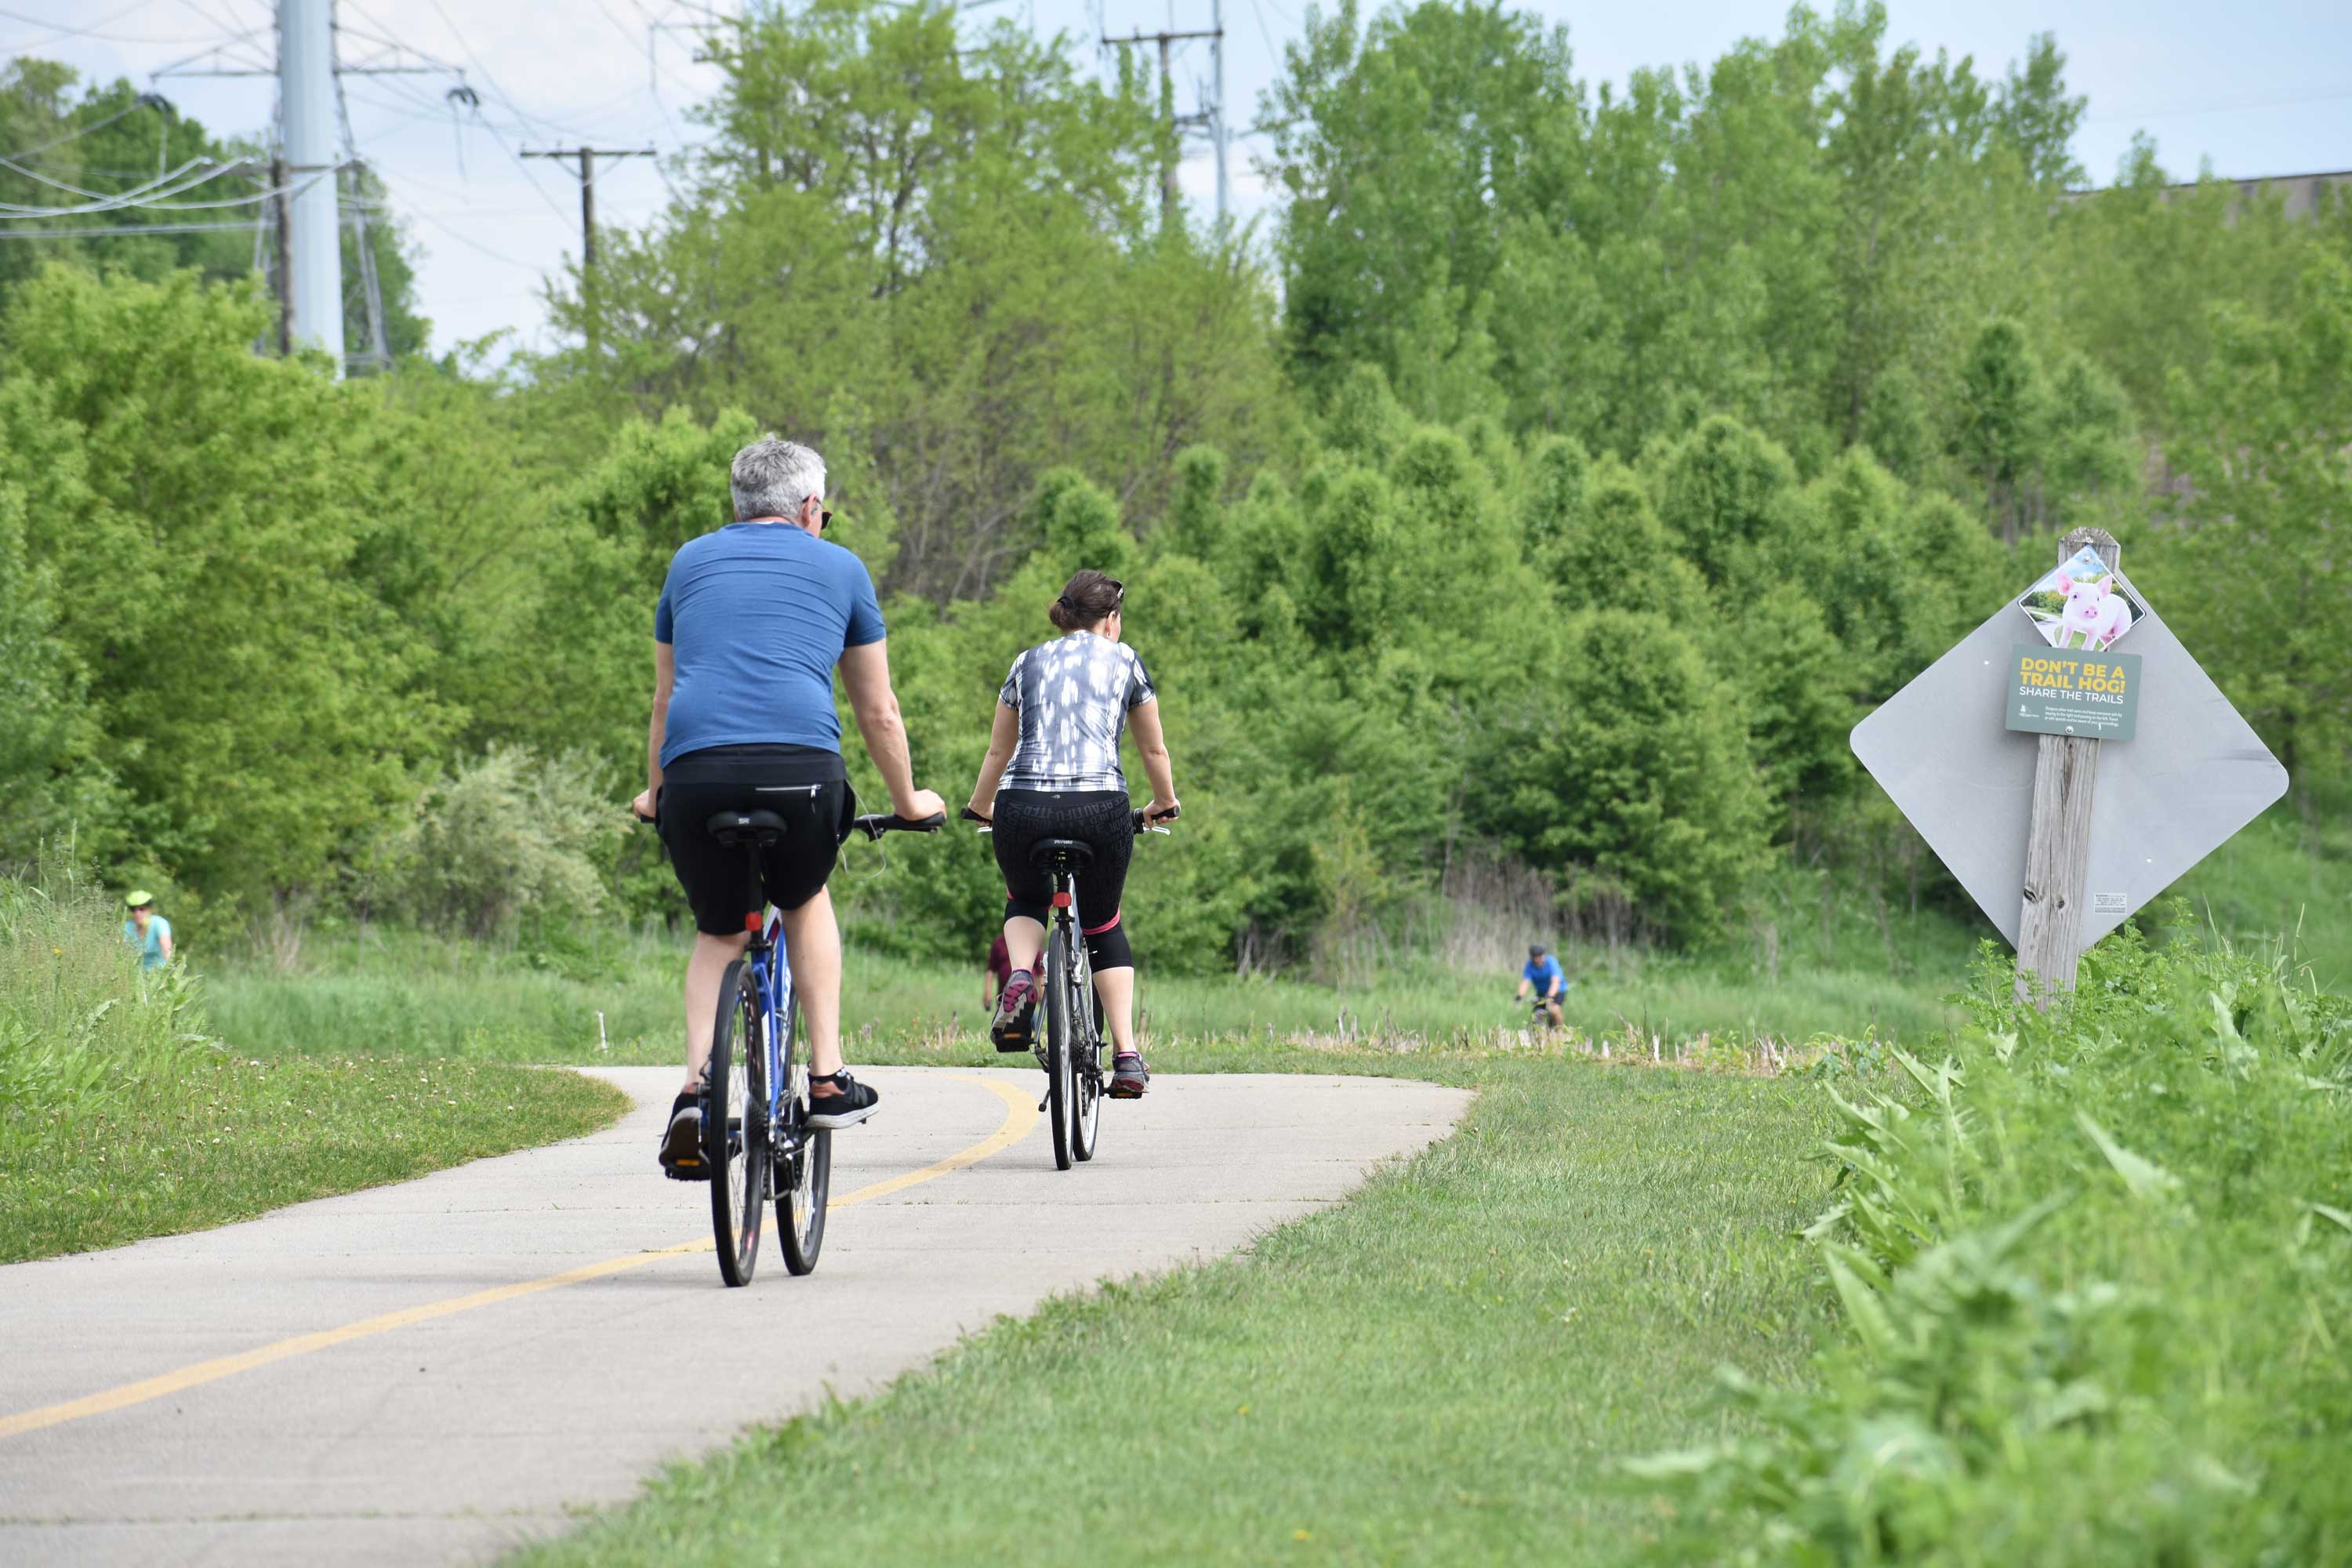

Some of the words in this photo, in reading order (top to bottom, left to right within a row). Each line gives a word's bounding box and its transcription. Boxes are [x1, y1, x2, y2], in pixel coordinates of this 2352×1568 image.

[2020, 657, 2078, 675] DON'T
[2083, 663, 2107, 677] BE
[2111, 665, 2125, 679] A
[2020, 671, 2073, 689] TRAIL
[2078, 677, 2125, 694] HOG!
[2020, 687, 2057, 699] SHARE
[2060, 690, 2082, 701] THE
[2085, 692, 2124, 704] TRAILS
